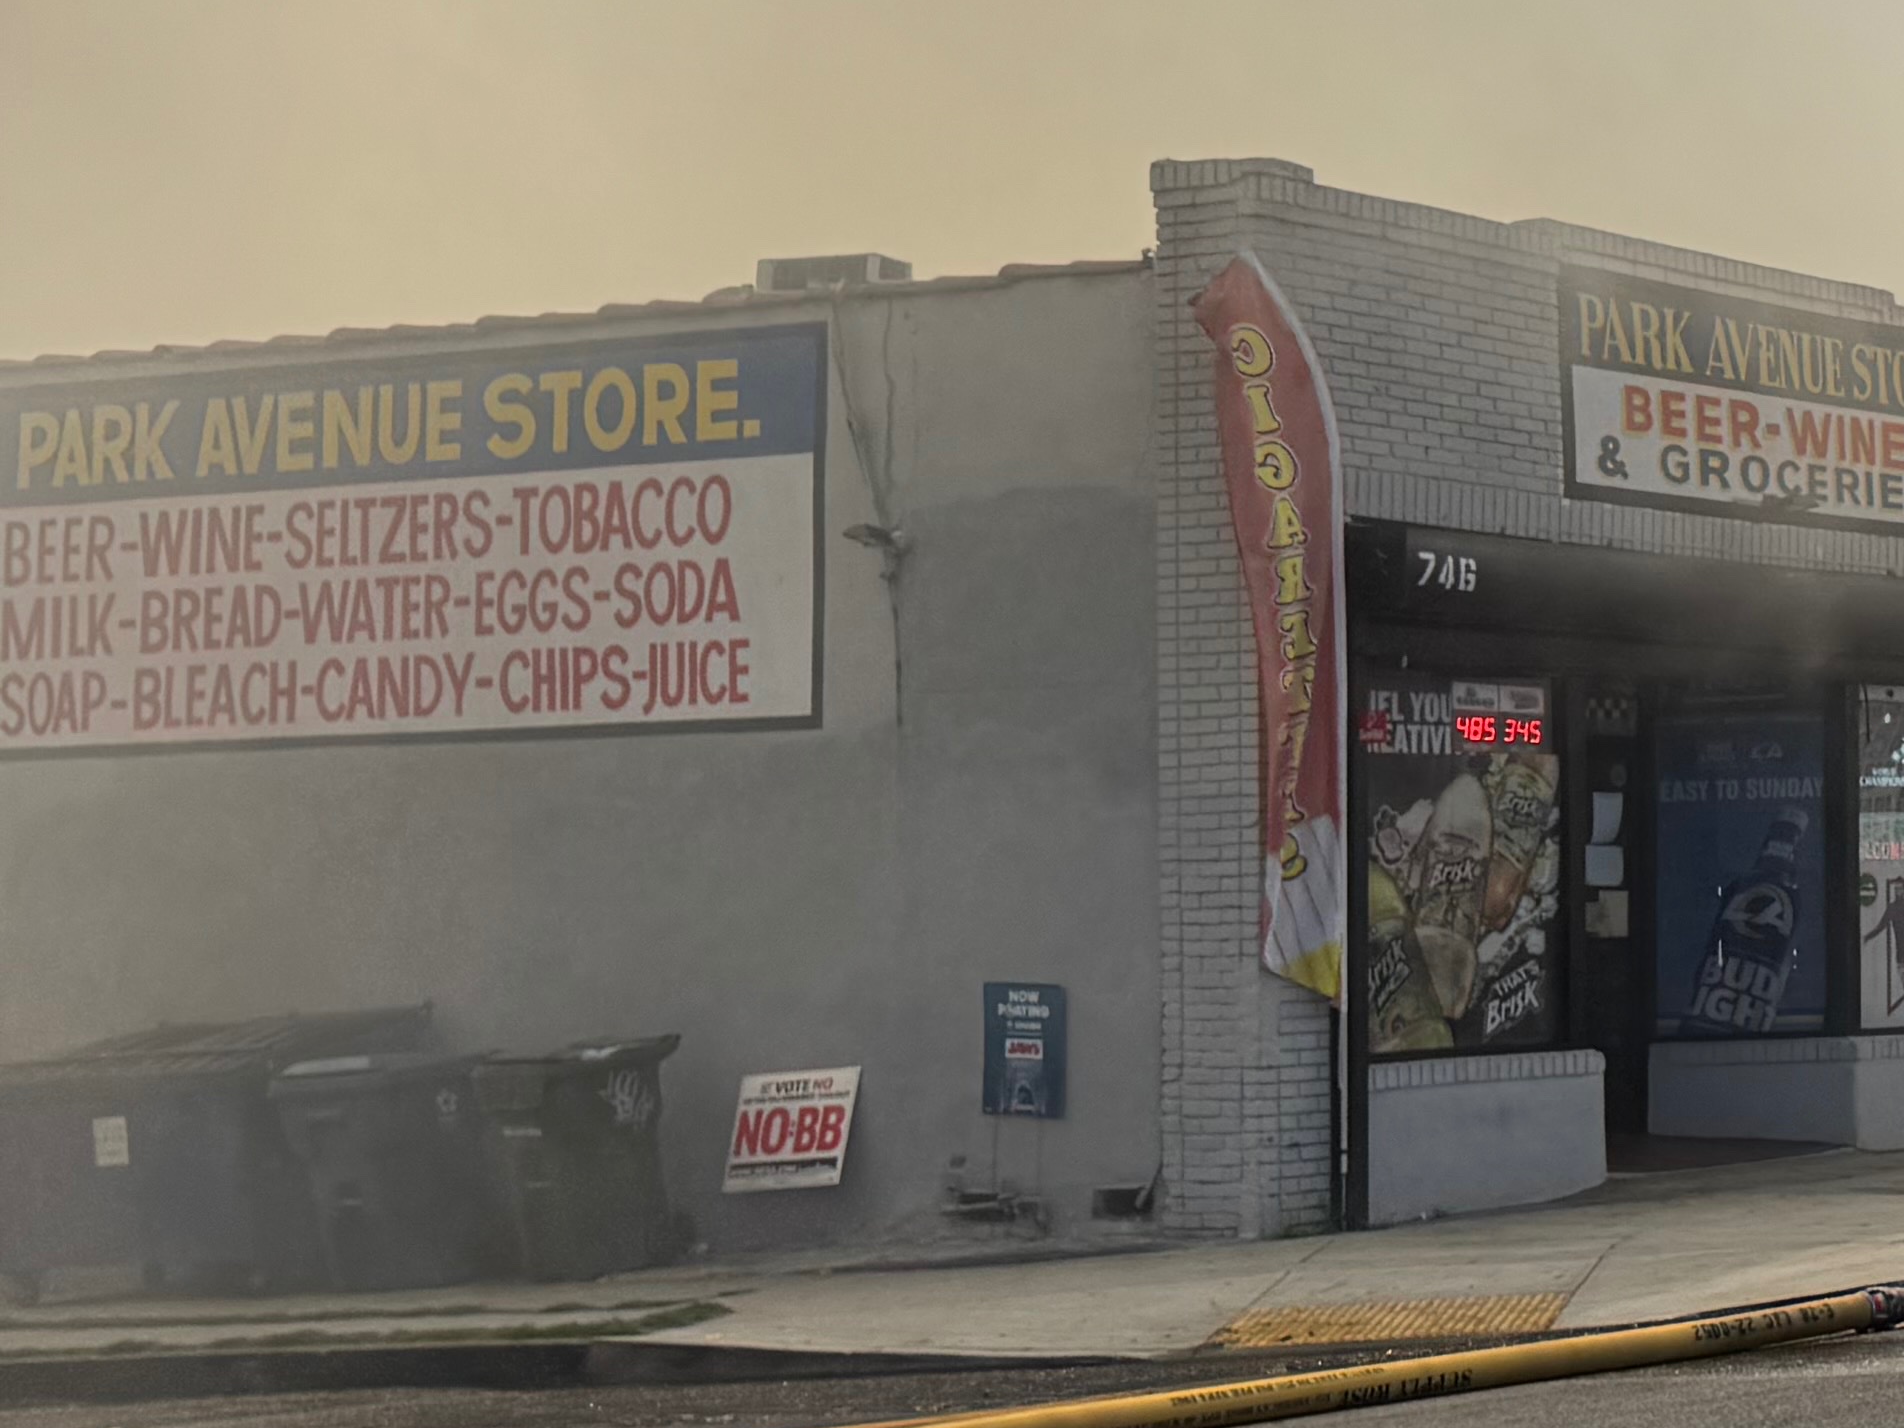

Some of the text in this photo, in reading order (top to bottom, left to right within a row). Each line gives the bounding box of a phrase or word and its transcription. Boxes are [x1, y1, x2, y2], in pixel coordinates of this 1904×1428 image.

[1577, 292, 1693, 372] PARK
[1706, 316, 1844, 397] AVENUE
[16, 359, 762, 489] PARK AVENUE STORE.
[1598, 435, 1628, 480] &
[1410, 692, 1451, 721] YOU
[1457, 717, 1496, 741] 485
[1504, 719, 1542, 743] 345
[1660, 776, 1824, 802] EASY TO SUNDAY
[1009, 990, 1039, 1003] NOW
[1400, 1369, 1474, 1397] SUPPLY
